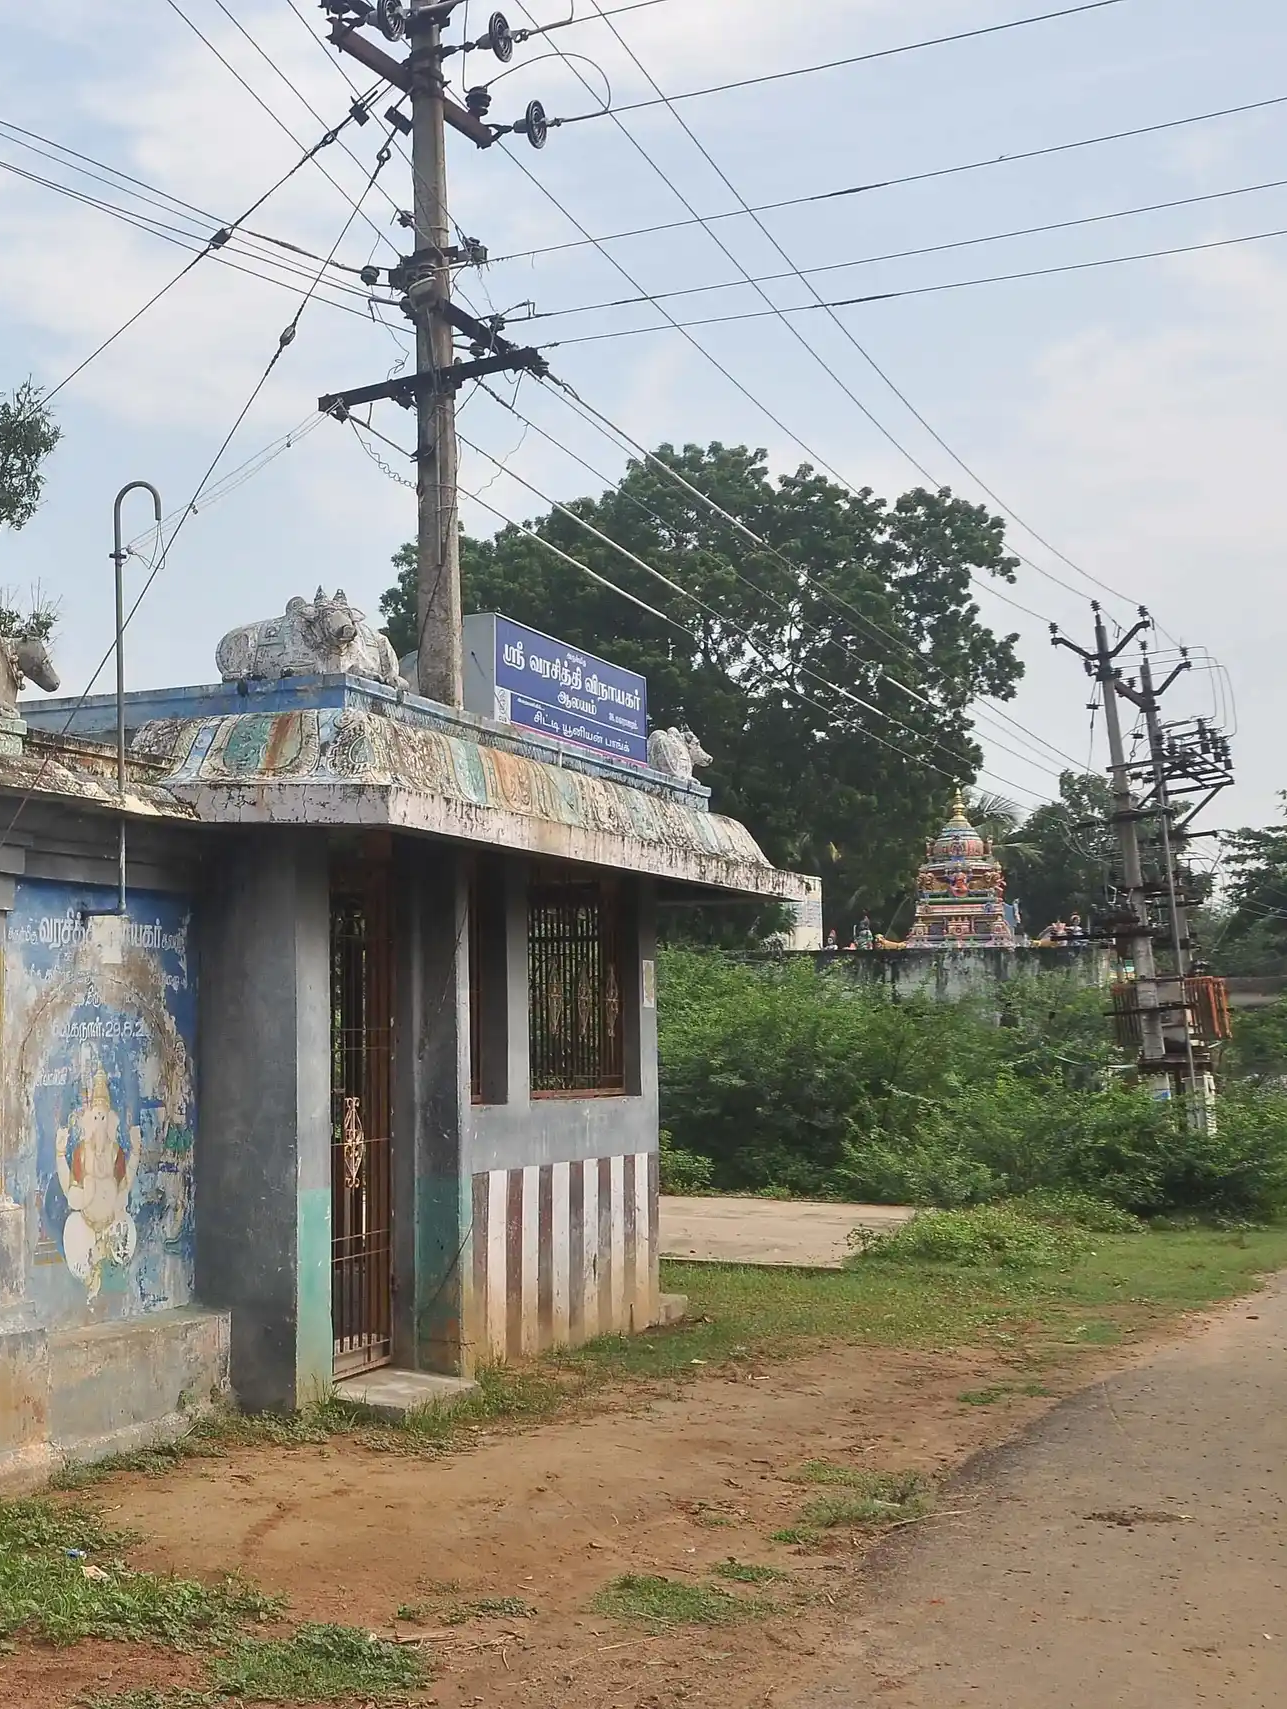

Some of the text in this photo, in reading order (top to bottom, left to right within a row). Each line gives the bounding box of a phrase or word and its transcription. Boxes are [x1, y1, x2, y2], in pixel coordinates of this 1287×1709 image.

[529, 655, 582, 690] வரசித்தி
[585, 674, 640, 711] விநாயகர்
[558, 691, 597, 715] ஆலயம்
[534, 711, 560, 732] சிட்டி
[562, 724, 603, 744] யூனியன்
